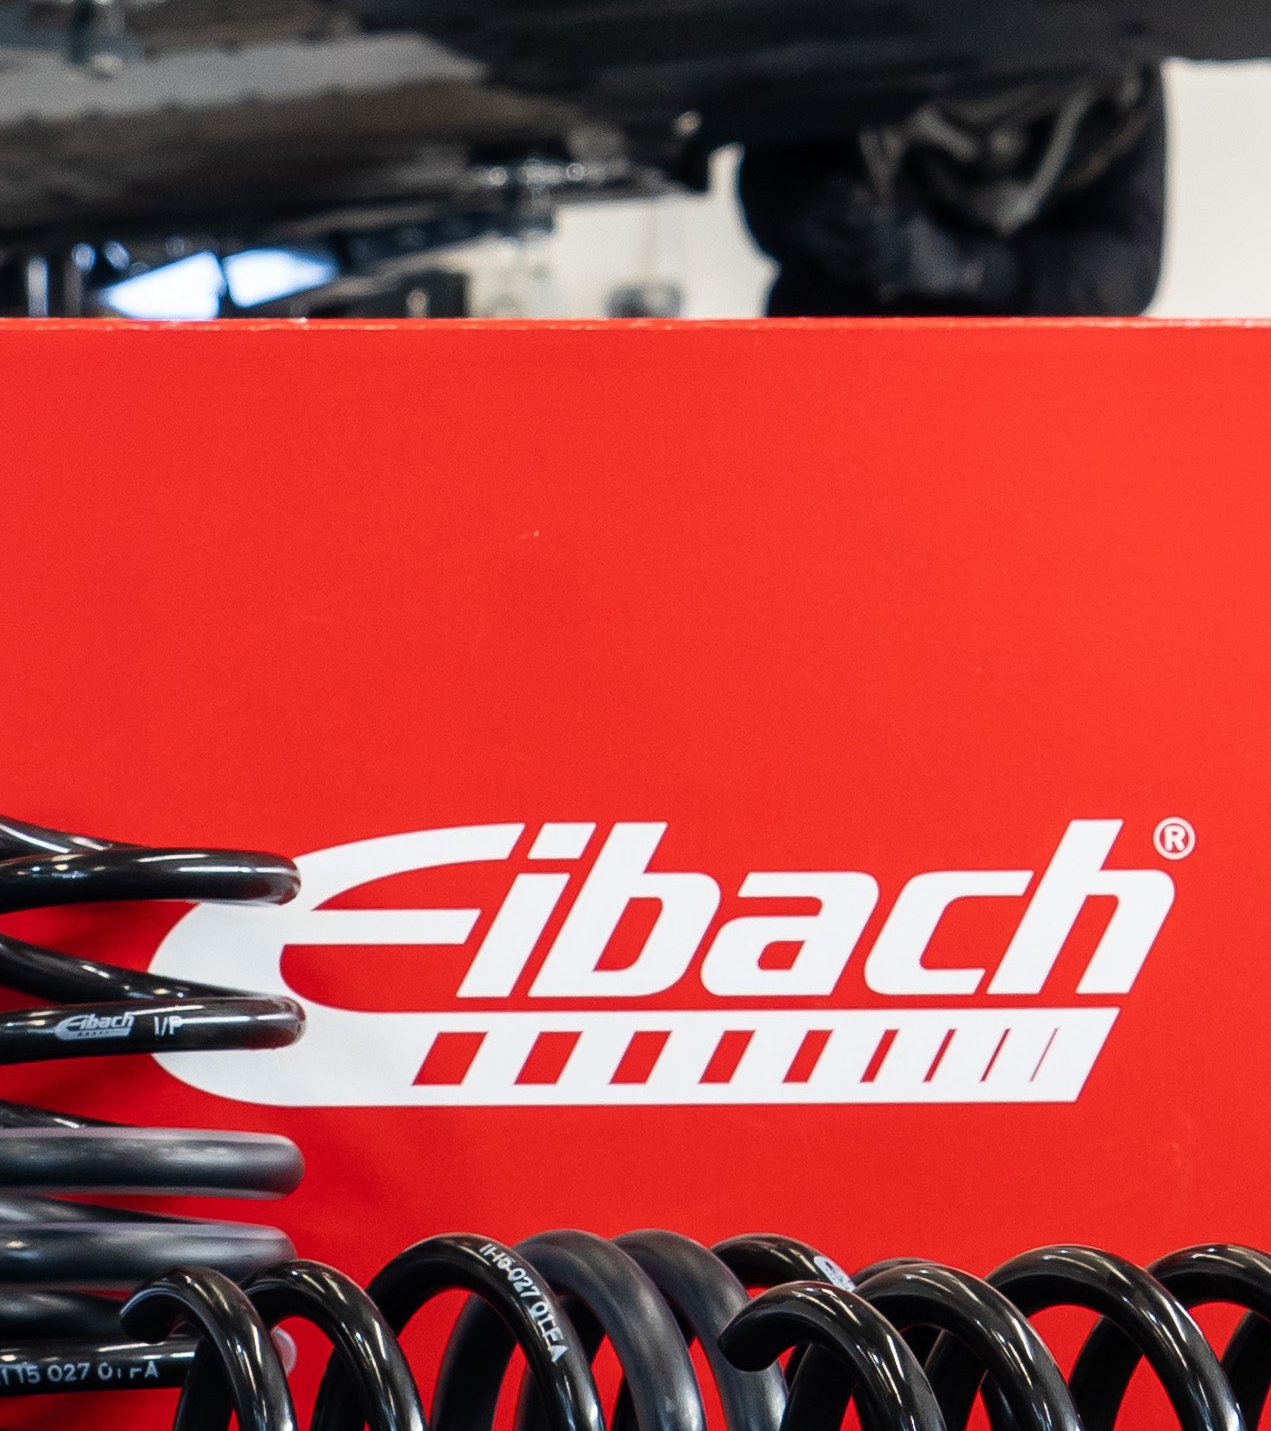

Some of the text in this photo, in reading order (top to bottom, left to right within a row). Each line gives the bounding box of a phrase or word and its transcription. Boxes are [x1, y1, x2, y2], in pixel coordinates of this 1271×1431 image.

[141, 817, 1176, 1107] Eibach
[54, 1011, 136, 1040] Eibach
[506, 1266, 542, 1299] 027
[46, 1362, 91, 1383] 027
